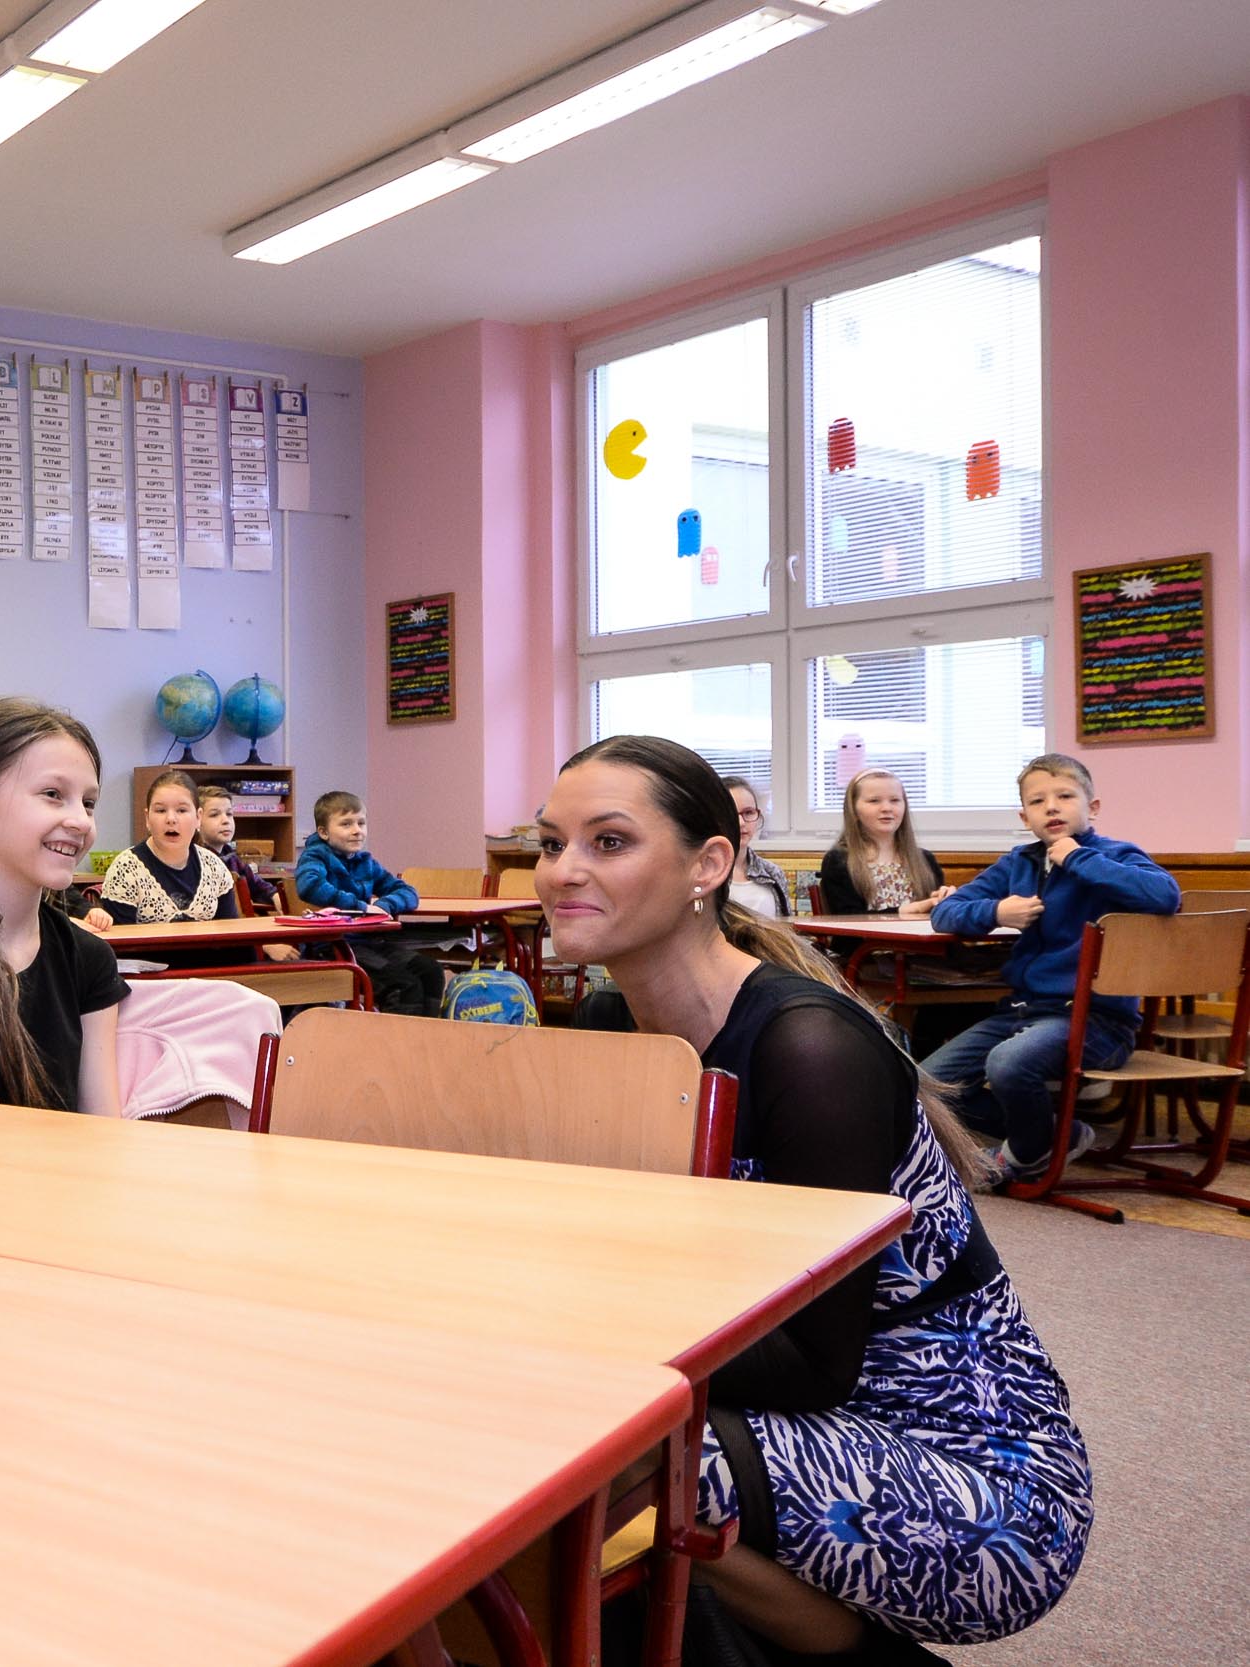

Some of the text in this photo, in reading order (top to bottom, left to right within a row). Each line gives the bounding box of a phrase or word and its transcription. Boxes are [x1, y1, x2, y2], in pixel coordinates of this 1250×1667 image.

[52, 372, 59, 383] L
[154, 383, 160, 395] P
[246, 393, 254, 404] V
[292, 397, 299, 407] Z
